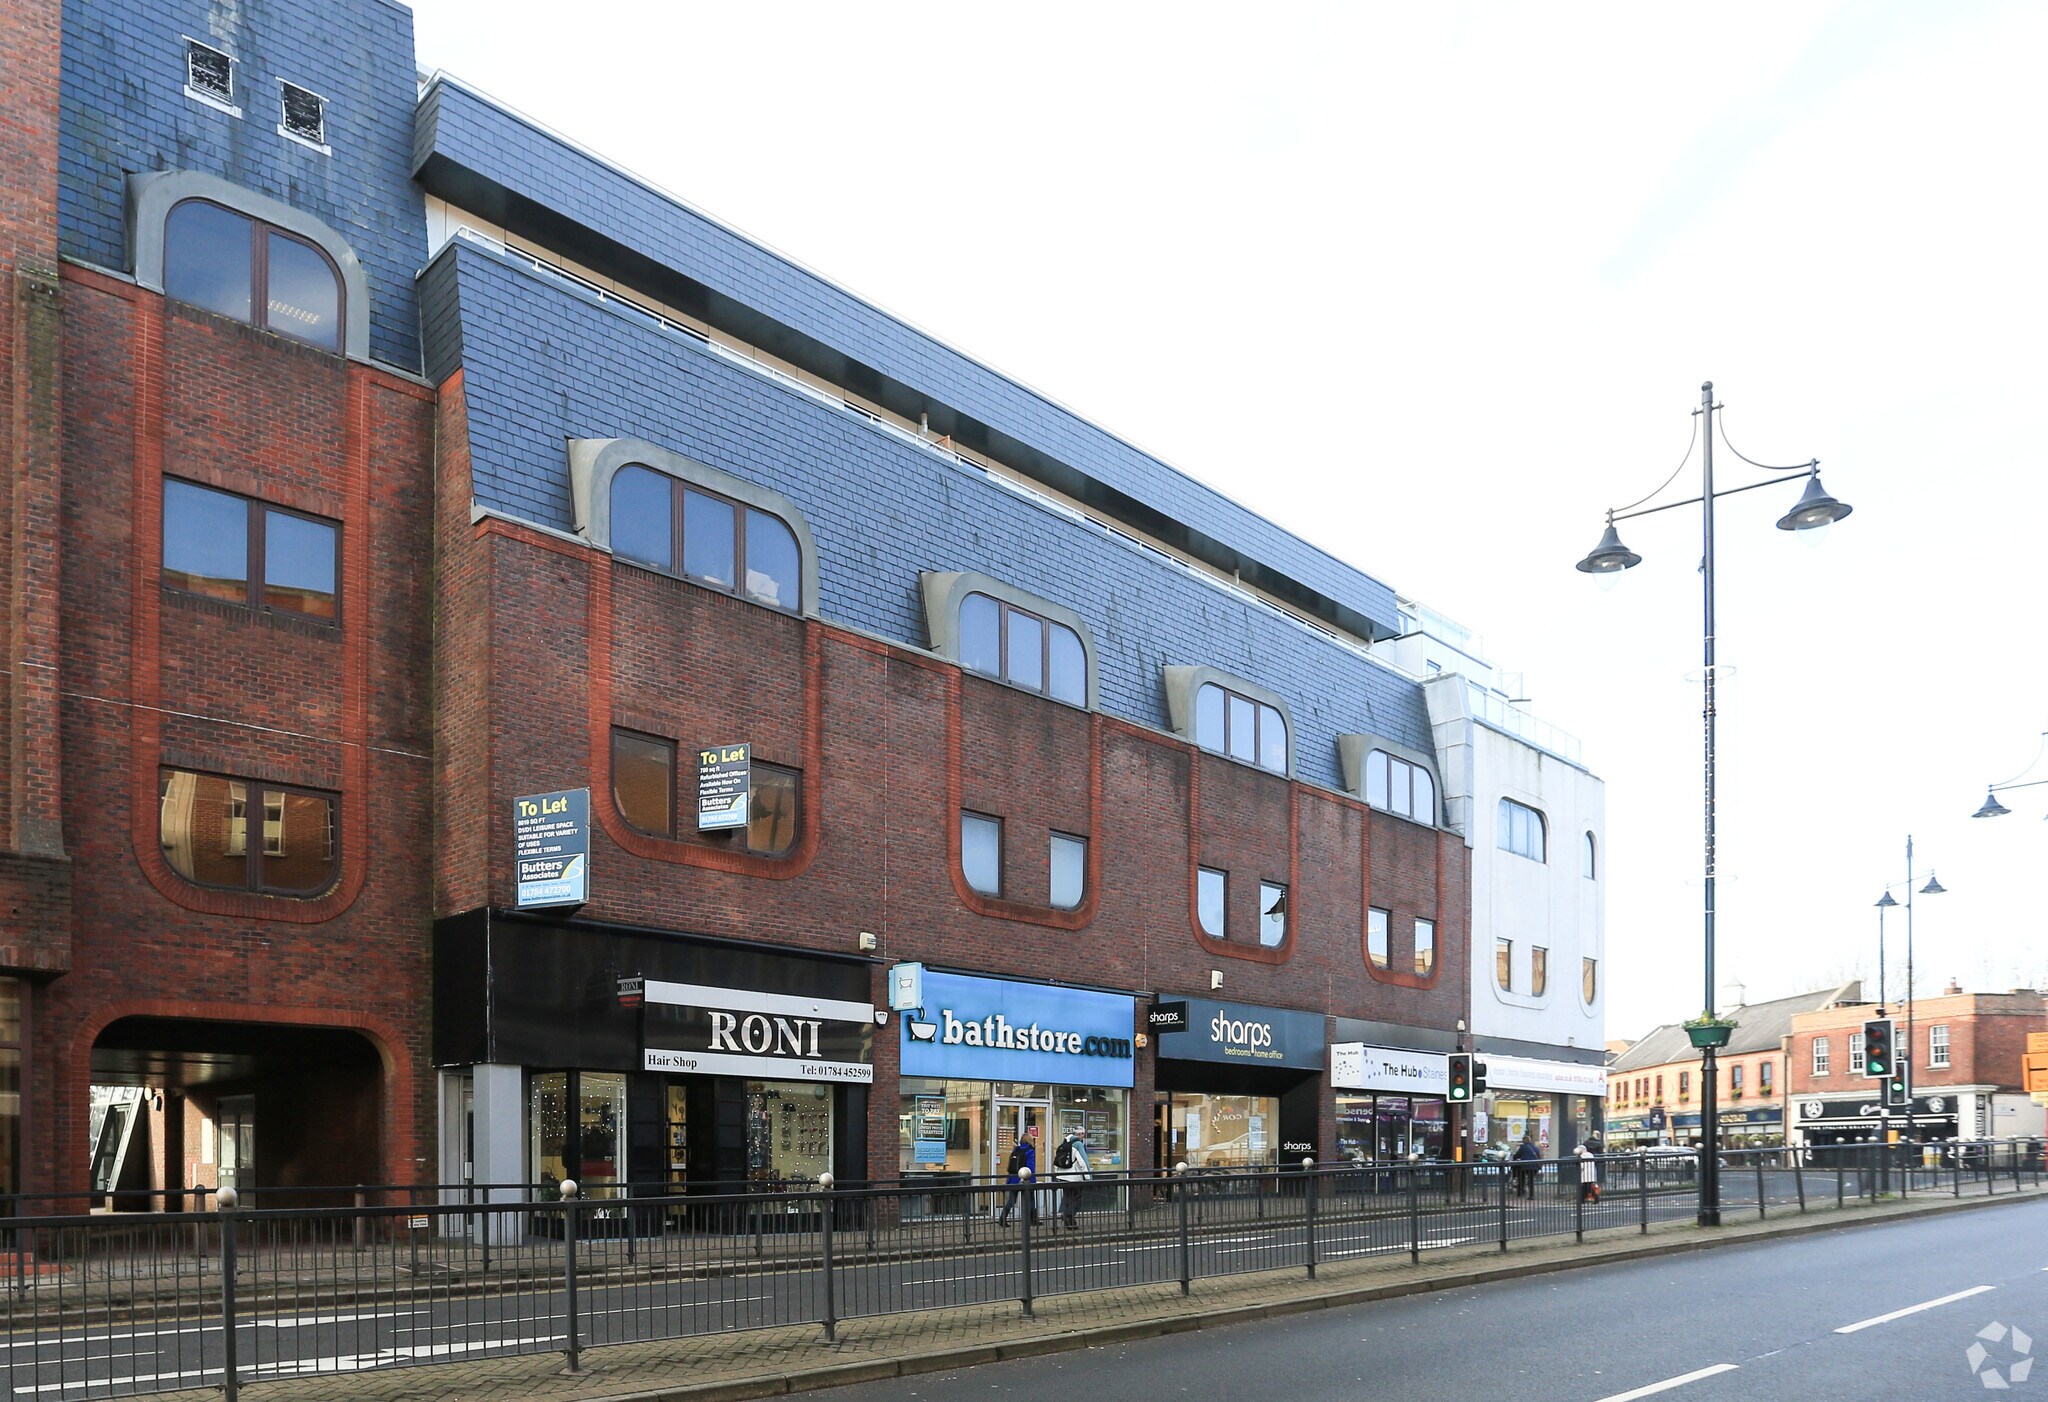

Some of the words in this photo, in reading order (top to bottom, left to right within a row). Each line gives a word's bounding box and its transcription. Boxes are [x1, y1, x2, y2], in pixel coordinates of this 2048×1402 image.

[700, 751, 718, 765] To
[721, 747, 745, 763] Let
[700, 780, 721, 788] Available
[700, 788, 718, 796] Flexible
[519, 801, 539, 817] To
[542, 796, 567, 814] Let
[702, 797, 731, 806] Butters
[533, 823, 555, 832] LEISURE
[556, 821, 574, 829] SPACE
[518, 832, 543, 841] SUITABLE
[543, 830, 555, 838] FOR
[556, 828, 579, 837] VARIETY
[526, 840, 541, 848] USES
[518, 847, 543, 856] FLEXIBLE
[543, 845, 562, 853] TERMS
[522, 861, 563, 874] Butters
[522, 872, 560, 881] Associates
[621, 981, 639, 992] RONI
[1149, 1012, 1179, 1024] sharps
[707, 1011, 822, 1057] RONI
[942, 1009, 1132, 1059] bathstore.com
[1211, 1009, 1272, 1054] sharps
[1225, 1047, 1251, 1056] bedrooms
[1254, 1049, 1268, 1058] home
[1269, 1050, 1284, 1058] office
[648, 1054, 671, 1067] Hair
[673, 1056, 698, 1071] Shop
[801, 1064, 817, 1076] Tel:
[819, 1065, 842, 1077] 01784
[843, 1066, 872, 1079] 452599
[1383, 1063, 1399, 1075] The
[1401, 1064, 1418, 1077] Hub
[1283, 1141, 1312, 1152] sharps
